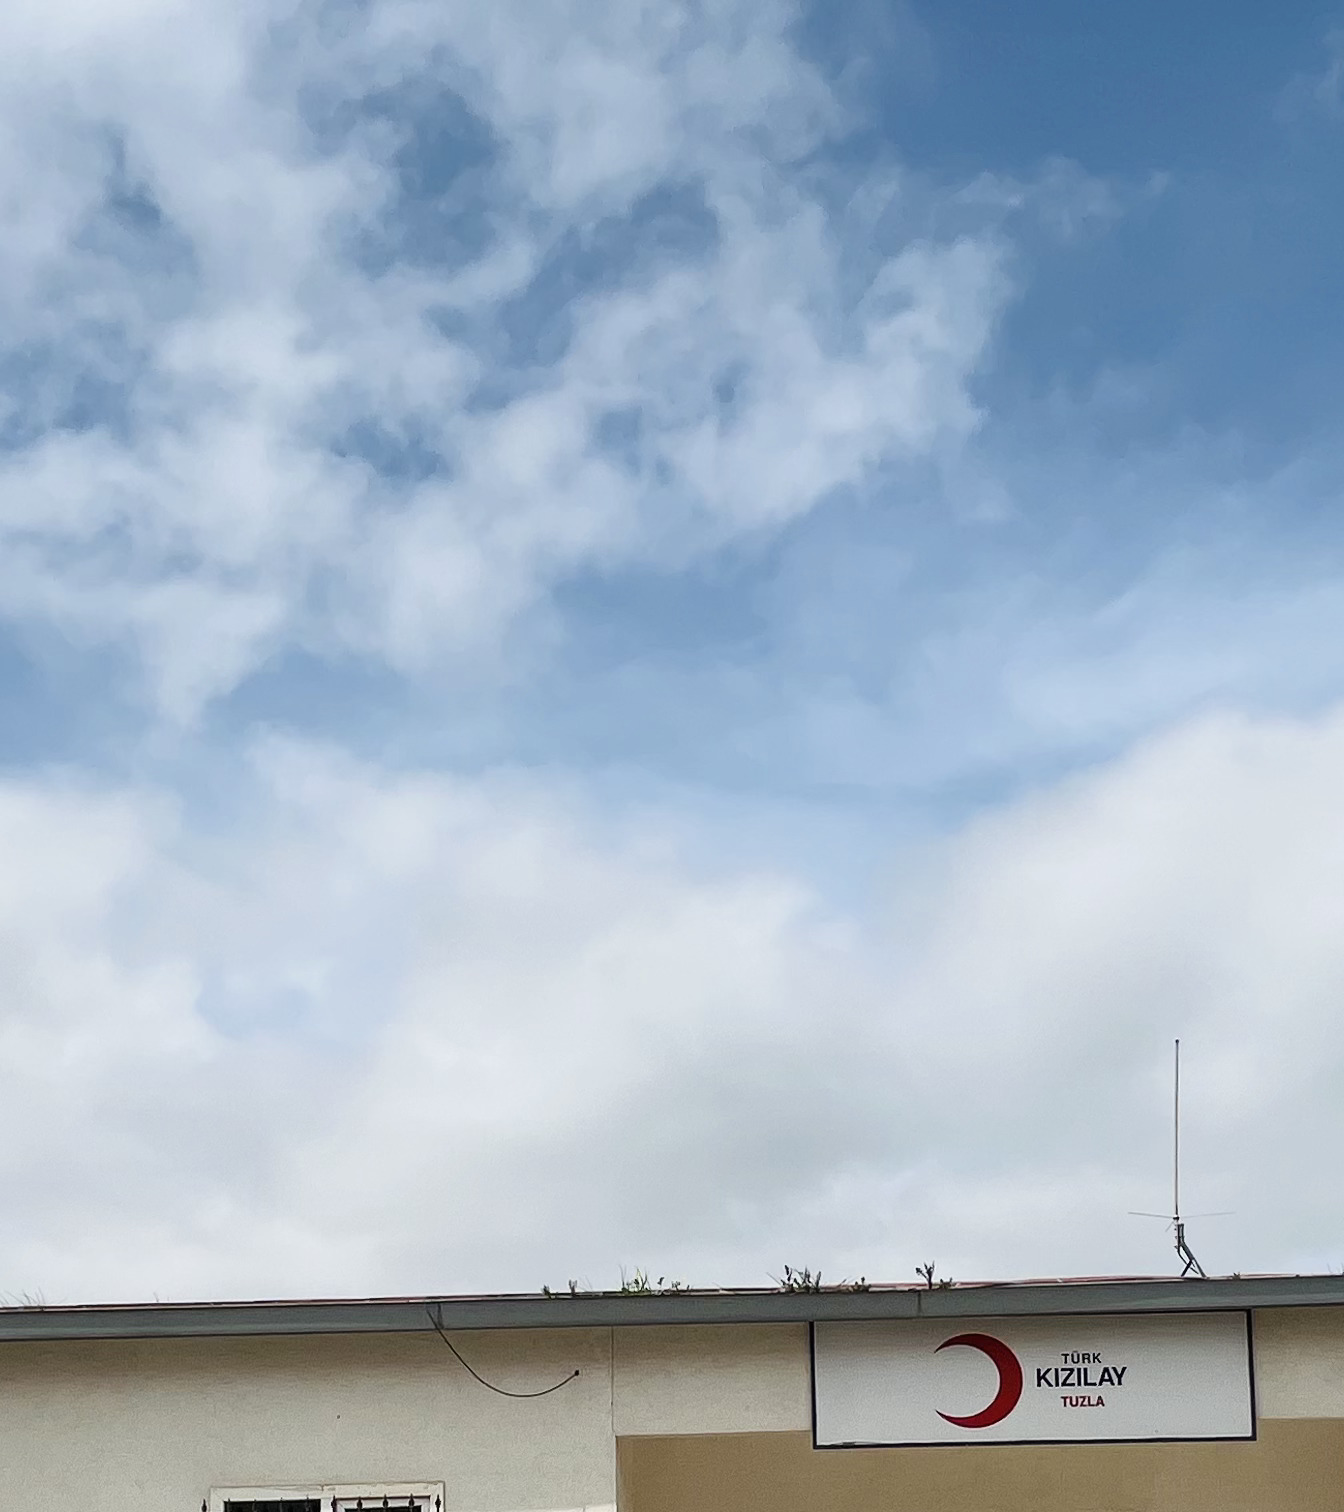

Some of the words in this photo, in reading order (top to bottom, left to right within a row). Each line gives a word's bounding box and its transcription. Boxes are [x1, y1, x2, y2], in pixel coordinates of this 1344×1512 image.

[1060, 1350, 1102, 1365] TÜRK
[1036, 1366, 1127, 1388] KIZILAY
[1060, 1395, 1105, 1407] TUZLA
